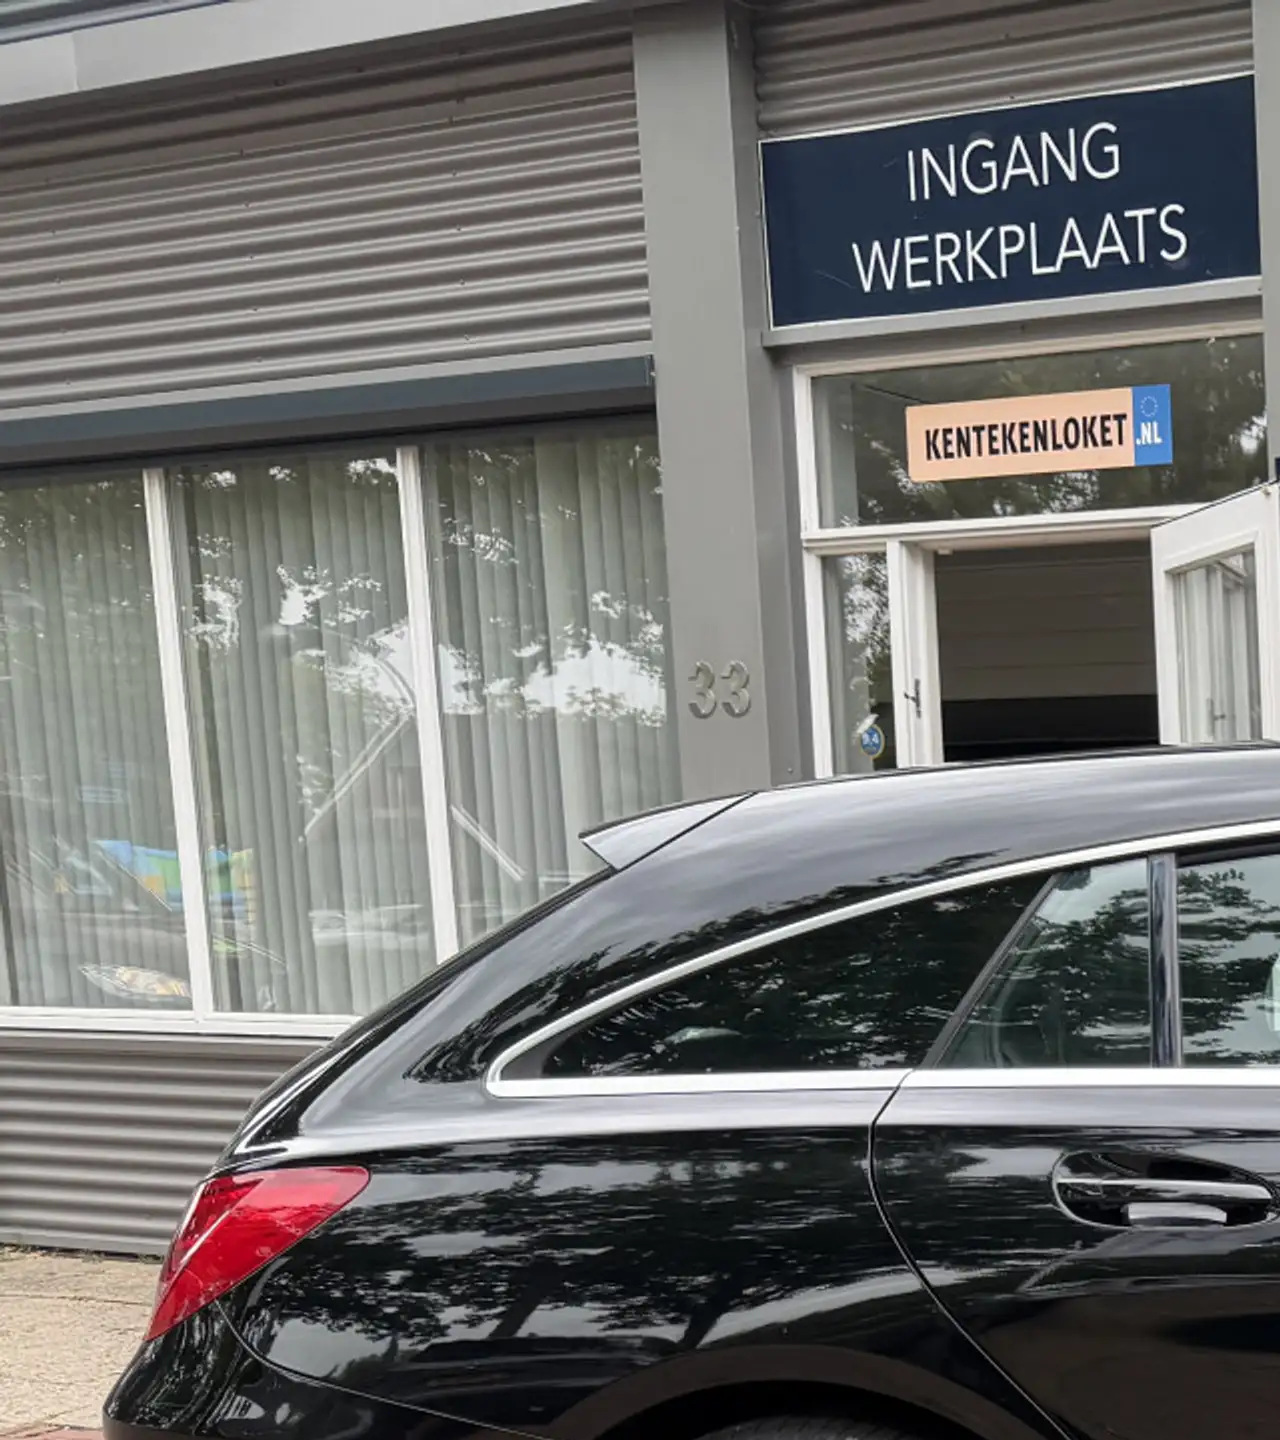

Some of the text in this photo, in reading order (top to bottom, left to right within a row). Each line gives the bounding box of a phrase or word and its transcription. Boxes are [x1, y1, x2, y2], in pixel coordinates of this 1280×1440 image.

[908, 122, 1120, 201] INGANG
[852, 204, 1187, 293] WERKPLAATS
[688, 659, 751, 720] 33
